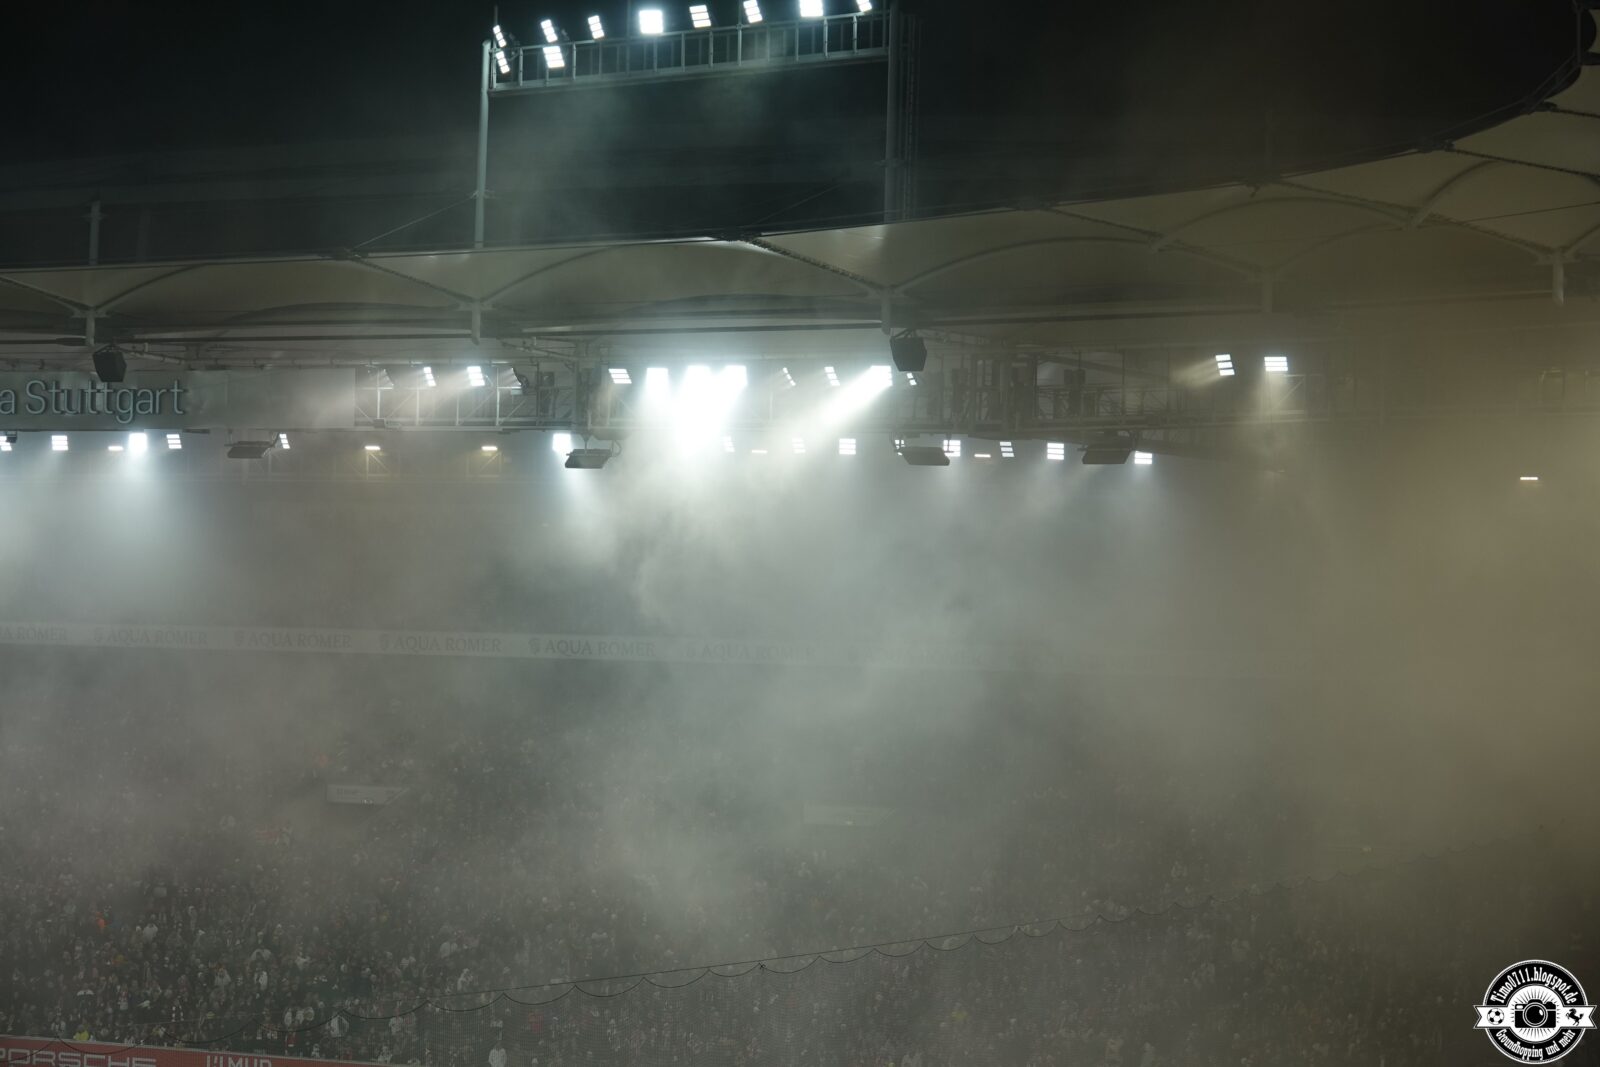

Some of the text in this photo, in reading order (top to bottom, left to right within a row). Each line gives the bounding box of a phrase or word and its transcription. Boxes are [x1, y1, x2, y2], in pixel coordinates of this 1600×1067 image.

[25, 379, 186, 424] Stuttgart
[247, 631, 293, 647] AQUA
[393, 635, 441, 653] AQUA
[545, 639, 593, 656] AQUA
[0, 1047, 157, 1067] ORSCHE
